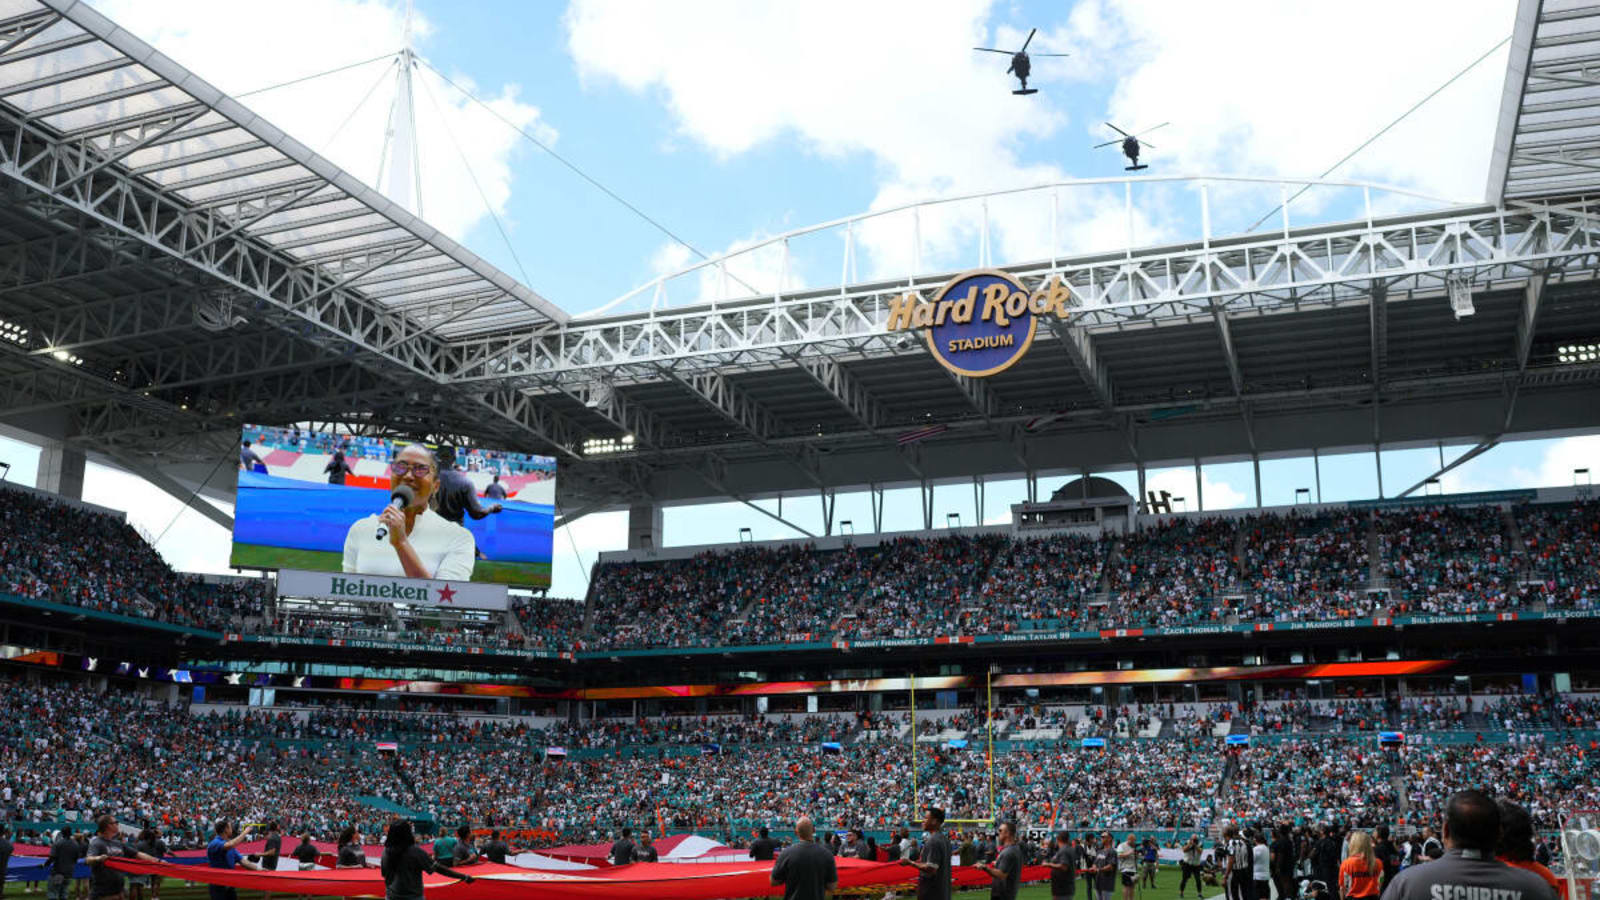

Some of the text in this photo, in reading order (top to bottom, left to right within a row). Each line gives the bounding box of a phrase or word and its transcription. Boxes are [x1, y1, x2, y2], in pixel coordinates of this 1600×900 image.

[887, 276, 1070, 331] Hard Rock
[949, 333, 1014, 352] STADIUM
[330, 577, 429, 601] Heineken
[1430, 883, 1522, 900] SECURITY
